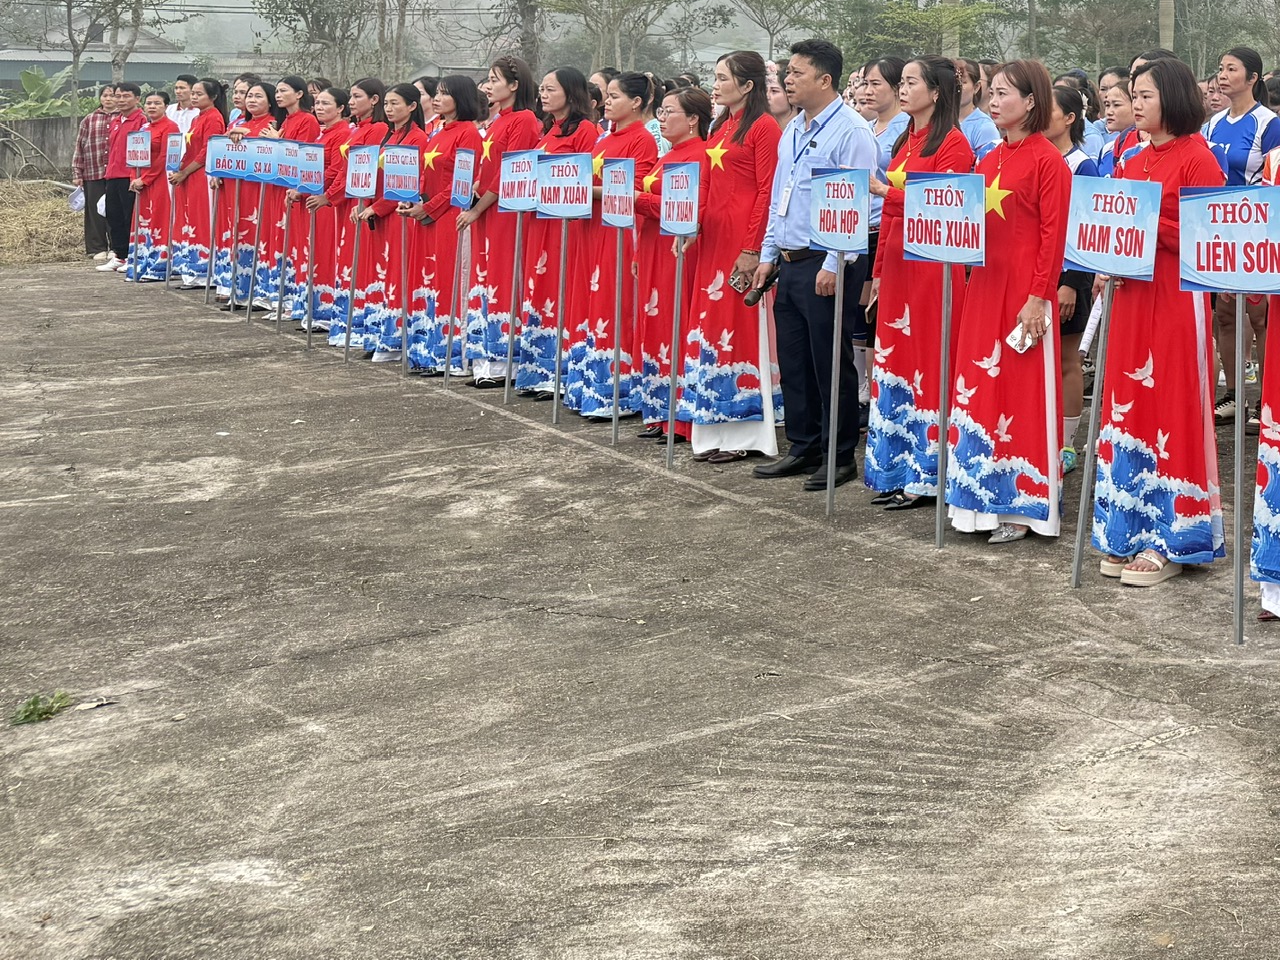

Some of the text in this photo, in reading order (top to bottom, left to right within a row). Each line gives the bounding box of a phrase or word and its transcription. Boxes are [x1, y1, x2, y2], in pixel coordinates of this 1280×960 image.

[256, 144, 273, 155] THÔN
[355, 151, 371, 165] THÔN
[215, 154, 247, 171] BẮC XU
[253, 161, 262, 174] SA
[511, 158, 533, 174] THÔN
[551, 161, 579, 178] THÔN
[610, 166, 627, 185] THÔN
[670, 171, 690, 190] THÔN
[502, 181, 516, 200] NAM
[515, 176, 527, 199] MỸ
[540, 181, 588, 205] NAM XUÂN
[825, 178, 855, 199] THÔN
[923, 185, 965, 207] THÔN
[617, 191, 633, 217] XUÂN
[664, 196, 694, 223] TÂY XUÂN
[1092, 191, 1138, 216] THÔN
[1207, 196, 1270, 224] THÔN
[819, 203, 859, 240] HÒA HỢP
[907, 213, 981, 250] ĐÔNG XUÂN
[1076, 222, 1146, 259] NAM SƠN
[1196, 234, 1236, 273] LIÊN
